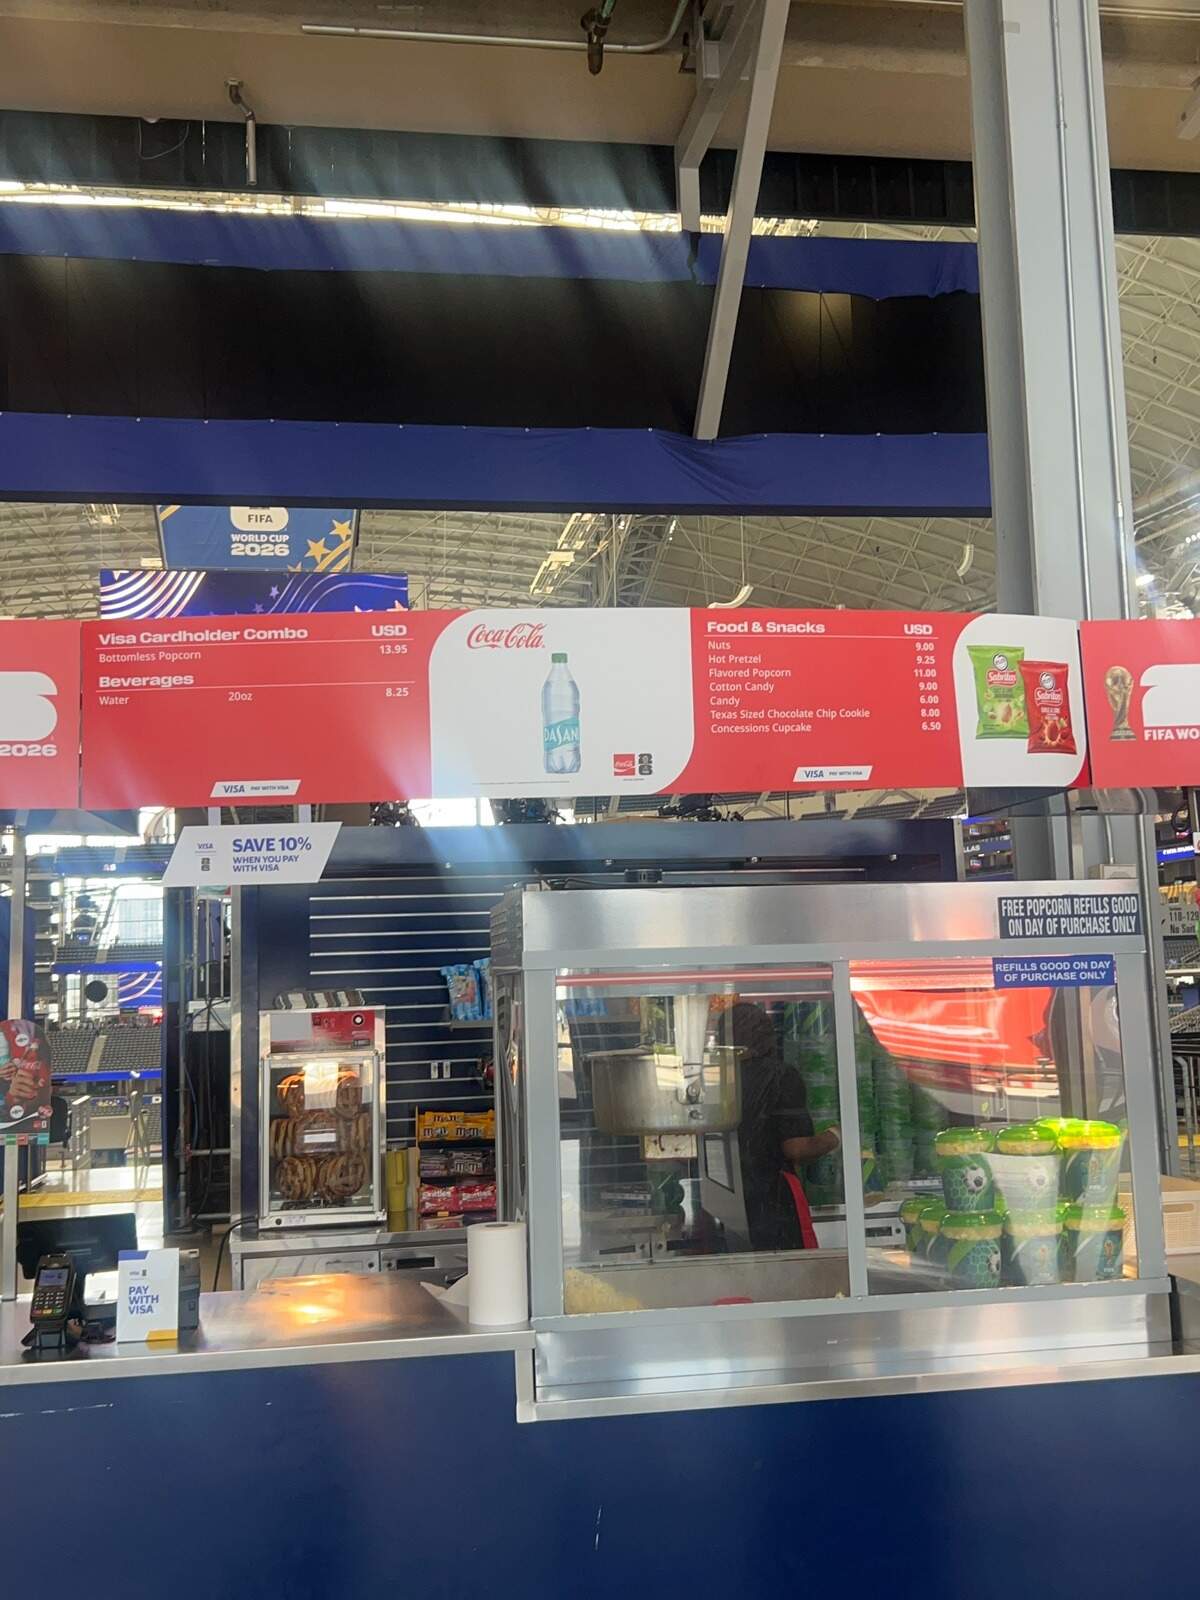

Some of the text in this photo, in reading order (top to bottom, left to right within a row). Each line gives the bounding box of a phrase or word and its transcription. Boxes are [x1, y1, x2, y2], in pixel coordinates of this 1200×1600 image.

[247, 514, 273, 523] FIFA
[231, 534, 290, 543] WORLD CUP
[231, 543, 290, 556] 2026
[707, 621, 933, 635] Food & Snacks USD
[98, 625, 407, 645] Visa Cardholder Combo USD
[708, 641, 935, 651] Nuts 9.00
[98, 645, 408, 663] Bottomless Popcorn 13.95
[708, 655, 936, 665] Hot Pretzel 9.25
[709, 668, 937, 679] Flavored Popcorn 11.00
[98, 674, 195, 688] Beverages
[709, 681, 938, 693] Cotton Candy 9.00
[98, 687, 409, 706] Water 20oz 8.25
[710, 695, 939, 707] Candy 6.00
[710, 708, 940, 720] Texas Sized Chocolate Chip Cookie 8.00
[710, 722, 942, 735] Concessions Cupcake 6.50
[1144, 729, 1175, 741] FIFA
[0, 744, 57, 757] 2026
[805, 770, 824, 778] VISA
[223, 785, 245, 793] VISA
[232, 836, 312, 853] SAVE 10%
[233, 855, 300, 864] WHEN YOU PAY
[233, 863, 280, 873] WITH VISA
[1002, 896, 1138, 917] FREE POPCORN REFILLS GOOD
[1008, 915, 1136, 936] ON DAY OF PURCHASE ONLY
[995, 960, 1111, 972] REFILLS GOOD ON DAY
[1004, 971, 1106, 982] OF PURCHASE ONLY
[128, 1286, 149, 1295] PAY
[129, 1295, 160, 1304] WITH
[128, 1305, 154, 1315] VISA
